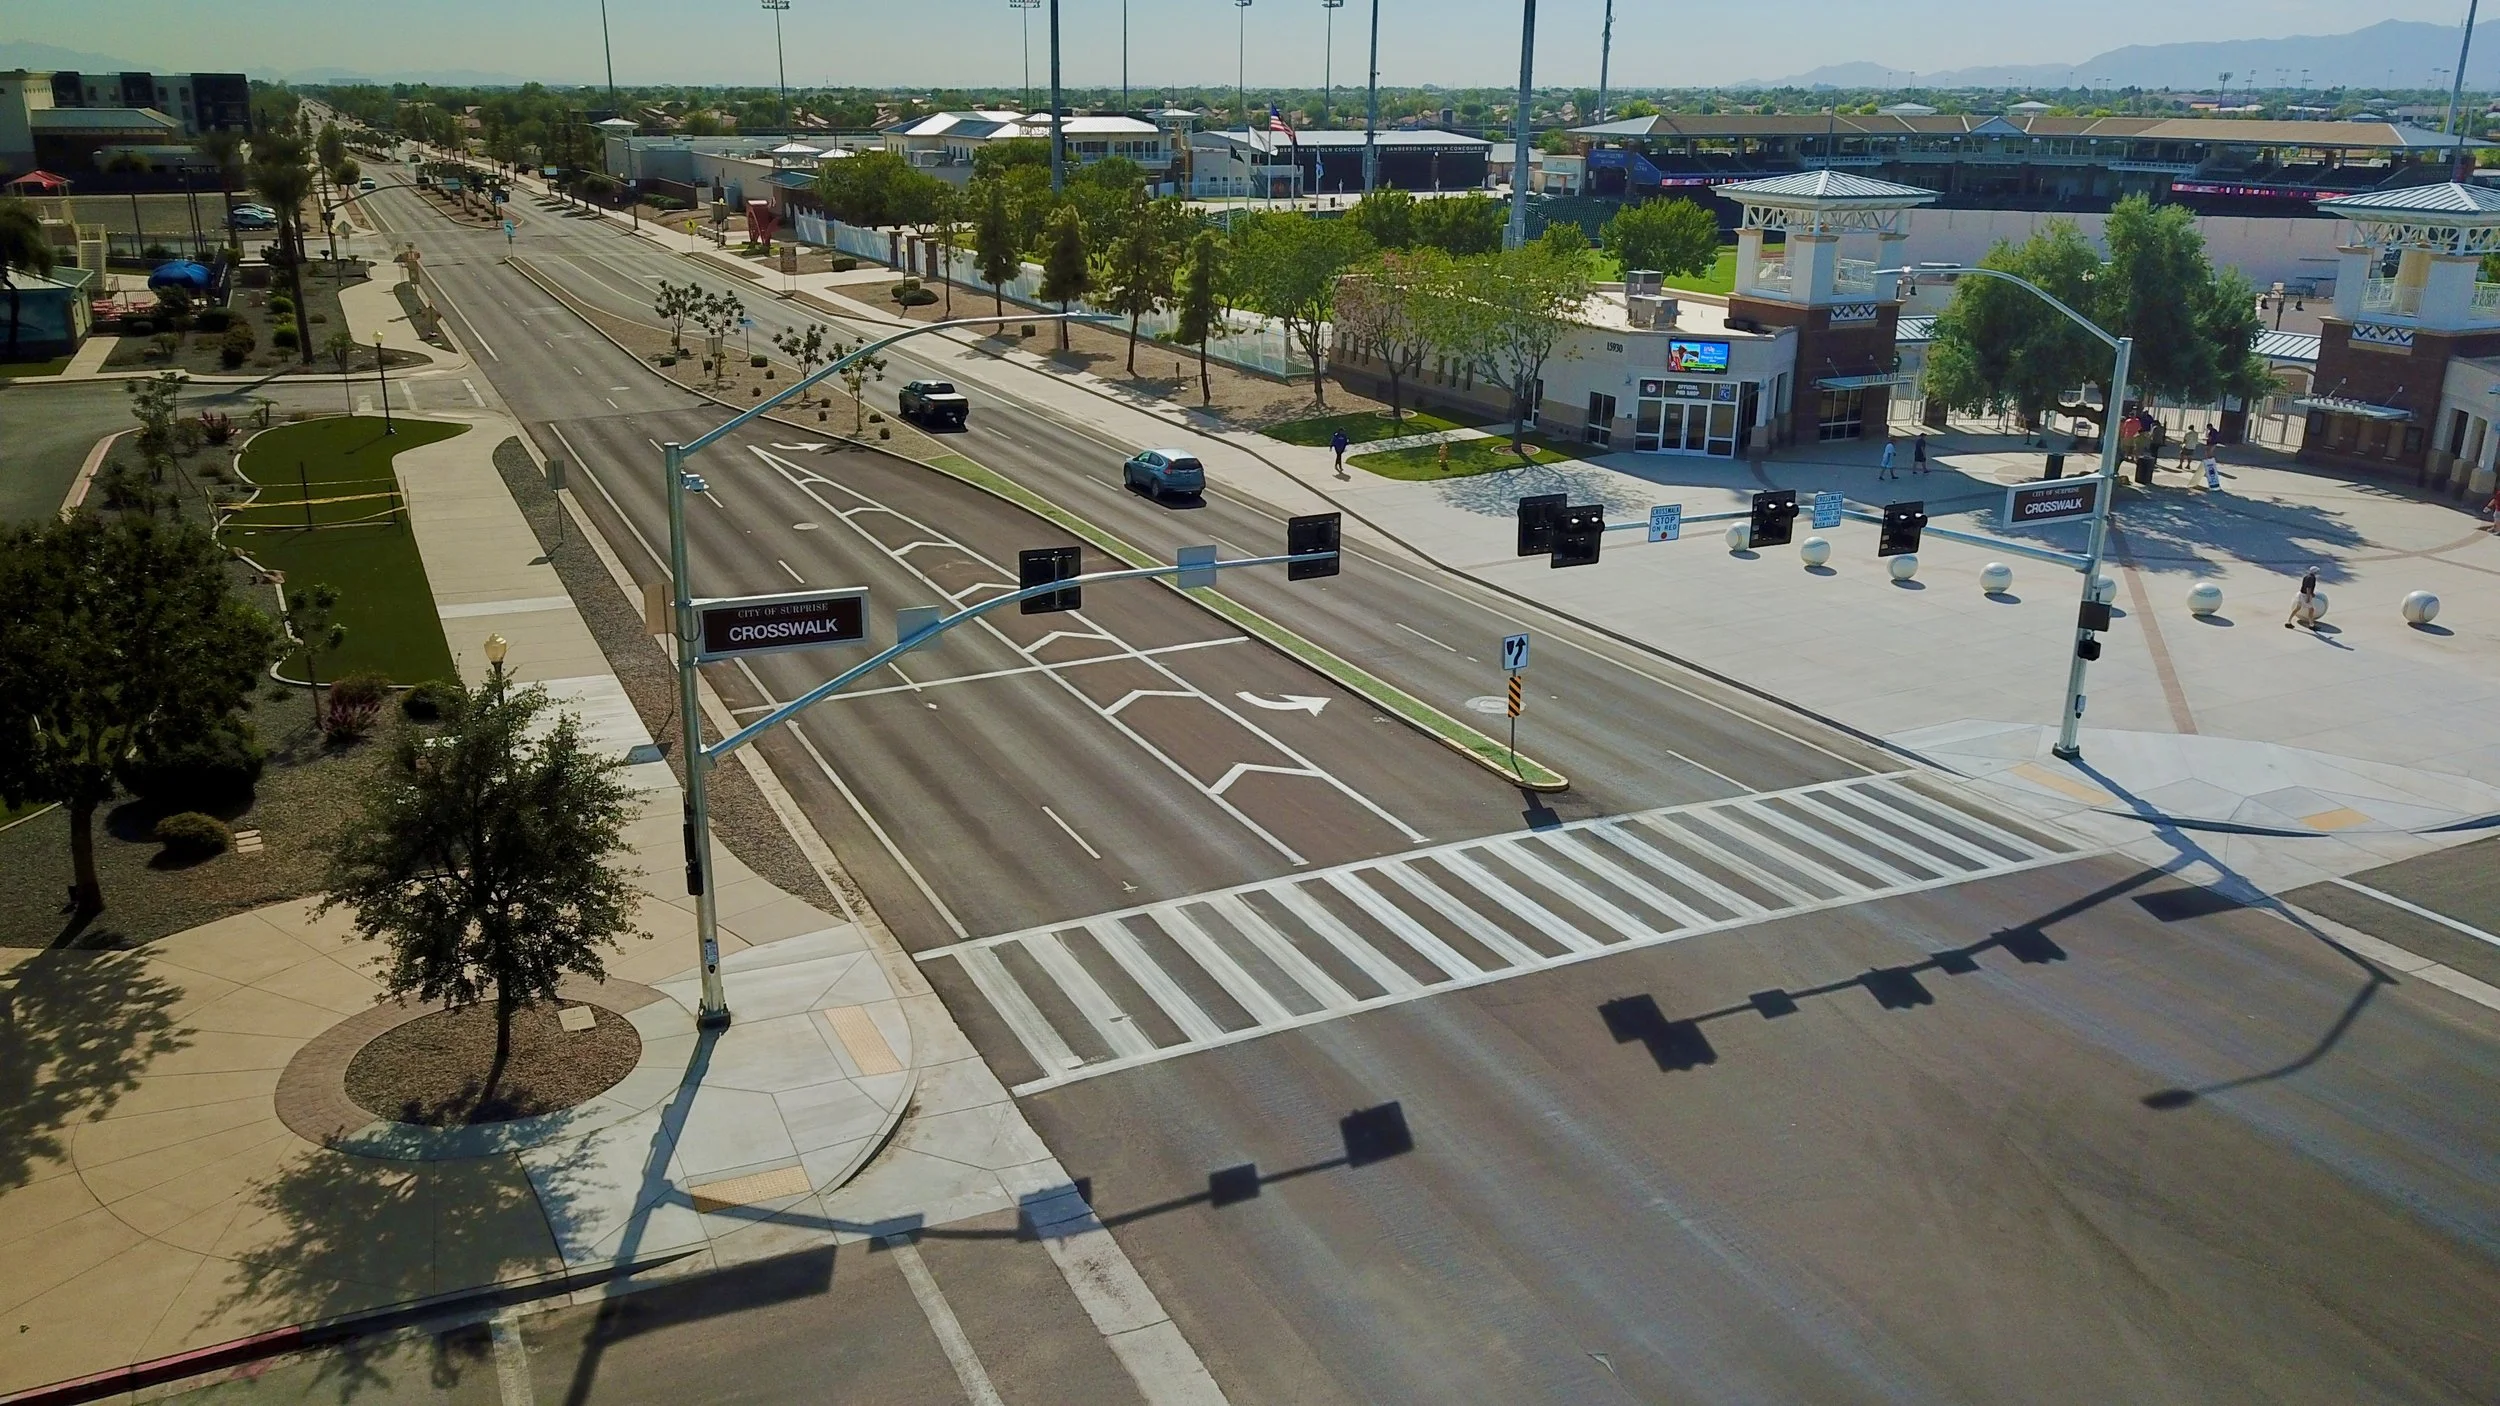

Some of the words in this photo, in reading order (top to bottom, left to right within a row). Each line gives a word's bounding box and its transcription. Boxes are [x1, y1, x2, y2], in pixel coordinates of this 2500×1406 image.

[1607, 341, 1624, 353] 15930
[1652, 507, 1679, 515] CROSSWALK
[2025, 498, 2083, 515] CROSSWALK
[1655, 516, 1676, 525] STOP
[738, 608, 760, 618] CITY
[764, 607, 777, 616] OF
[781, 603, 828, 615] SURPRISE
[729, 618, 838, 642] CROSSWALK
